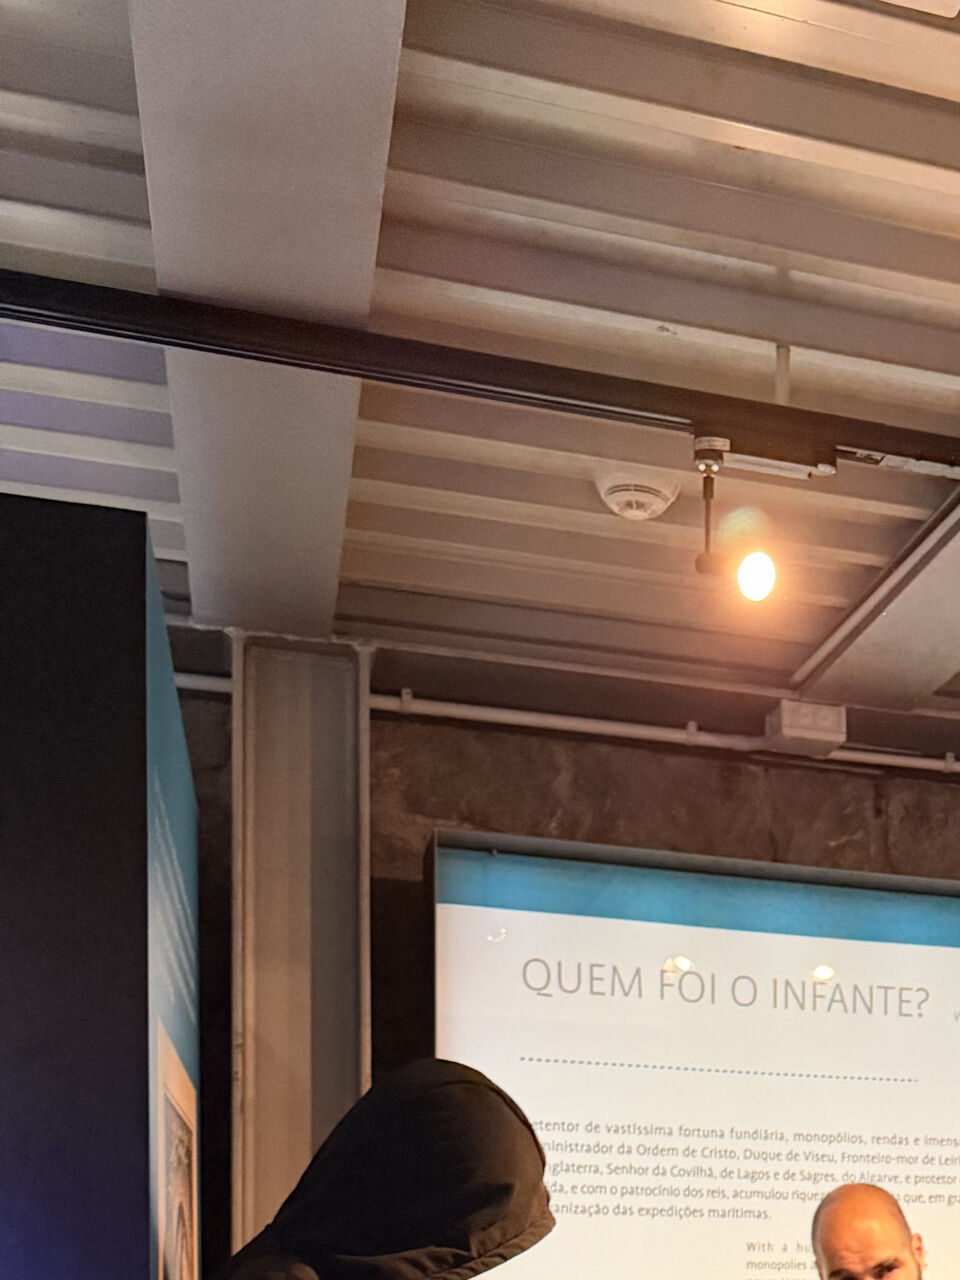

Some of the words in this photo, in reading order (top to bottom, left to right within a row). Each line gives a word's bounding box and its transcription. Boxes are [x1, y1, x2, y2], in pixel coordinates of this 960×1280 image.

[522, 958, 643, 998] QUEM
[659, 969, 716, 1004] FOI
[731, 975, 758, 1007] O
[773, 977, 930, 1018] INFANTE?
[534, 1121, 580, 1133] tentor
[584, 1121, 601, 1134] de
[678, 1124, 725, 1139] fortuna
[730, 1126, 789, 1143] fundiária,
[793, 1131, 867, 1147] monopólios,
[871, 1133, 910, 1146] rendas
[913, 1136, 920, 1146] e
[543, 1139, 614, 1155] inistrador
[617, 1141, 632, 1155] da
[636, 1143, 679, 1158] Ordem
[682, 1144, 698, 1158] de
[700, 1145, 740, 1161] Cristo,
[743, 1149, 783, 1164] Duque
[786, 1150, 800, 1162] de
[803, 1150, 838, 1165] Viseu,
[841, 1152, 919, 1166] Fronteiro-mor
[922, 1153, 935, 1166] de
[549, 1161, 604, 1177] glaterra,
[606, 1161, 650, 1176] Senhor
[652, 1163, 668, 1177] da
[670, 1165, 718, 1179] Covilhã,
[720, 1165, 734, 1179] de
[737, 1167, 771, 1183] Lagos
[773, 1170, 780, 1181] e
[783, 1169, 796, 1182] de
[799, 1170, 839, 1185] Sagres,
[904, 1175, 911, 1185] e
[914, 1174, 958, 1188] protetor
[550, 1180, 568, 1196] da,
[571, 1184, 578, 1195] e
[580, 1184, 607, 1196] com
[609, 1186, 618, 1196] o
[620, 1185, 681, 1202] patrocínio
[683, 1185, 704, 1199] dos
[706, 1186, 731, 1201] reis,
[732, 1188, 789, 1202] acumulou
[791, 1189, 822, 1204] rique
[928, 1194, 944, 1205] em
[552, 1203, 610, 1219] anização
[612, 1202, 634, 1217] das
[637, 1204, 705, 1220] expedições
[746, 1241, 774, 1252] With
[782, 1243, 788, 1252] a
[796, 1242, 812, 1253] hu
[746, 1258, 807, 1273] monopolies
